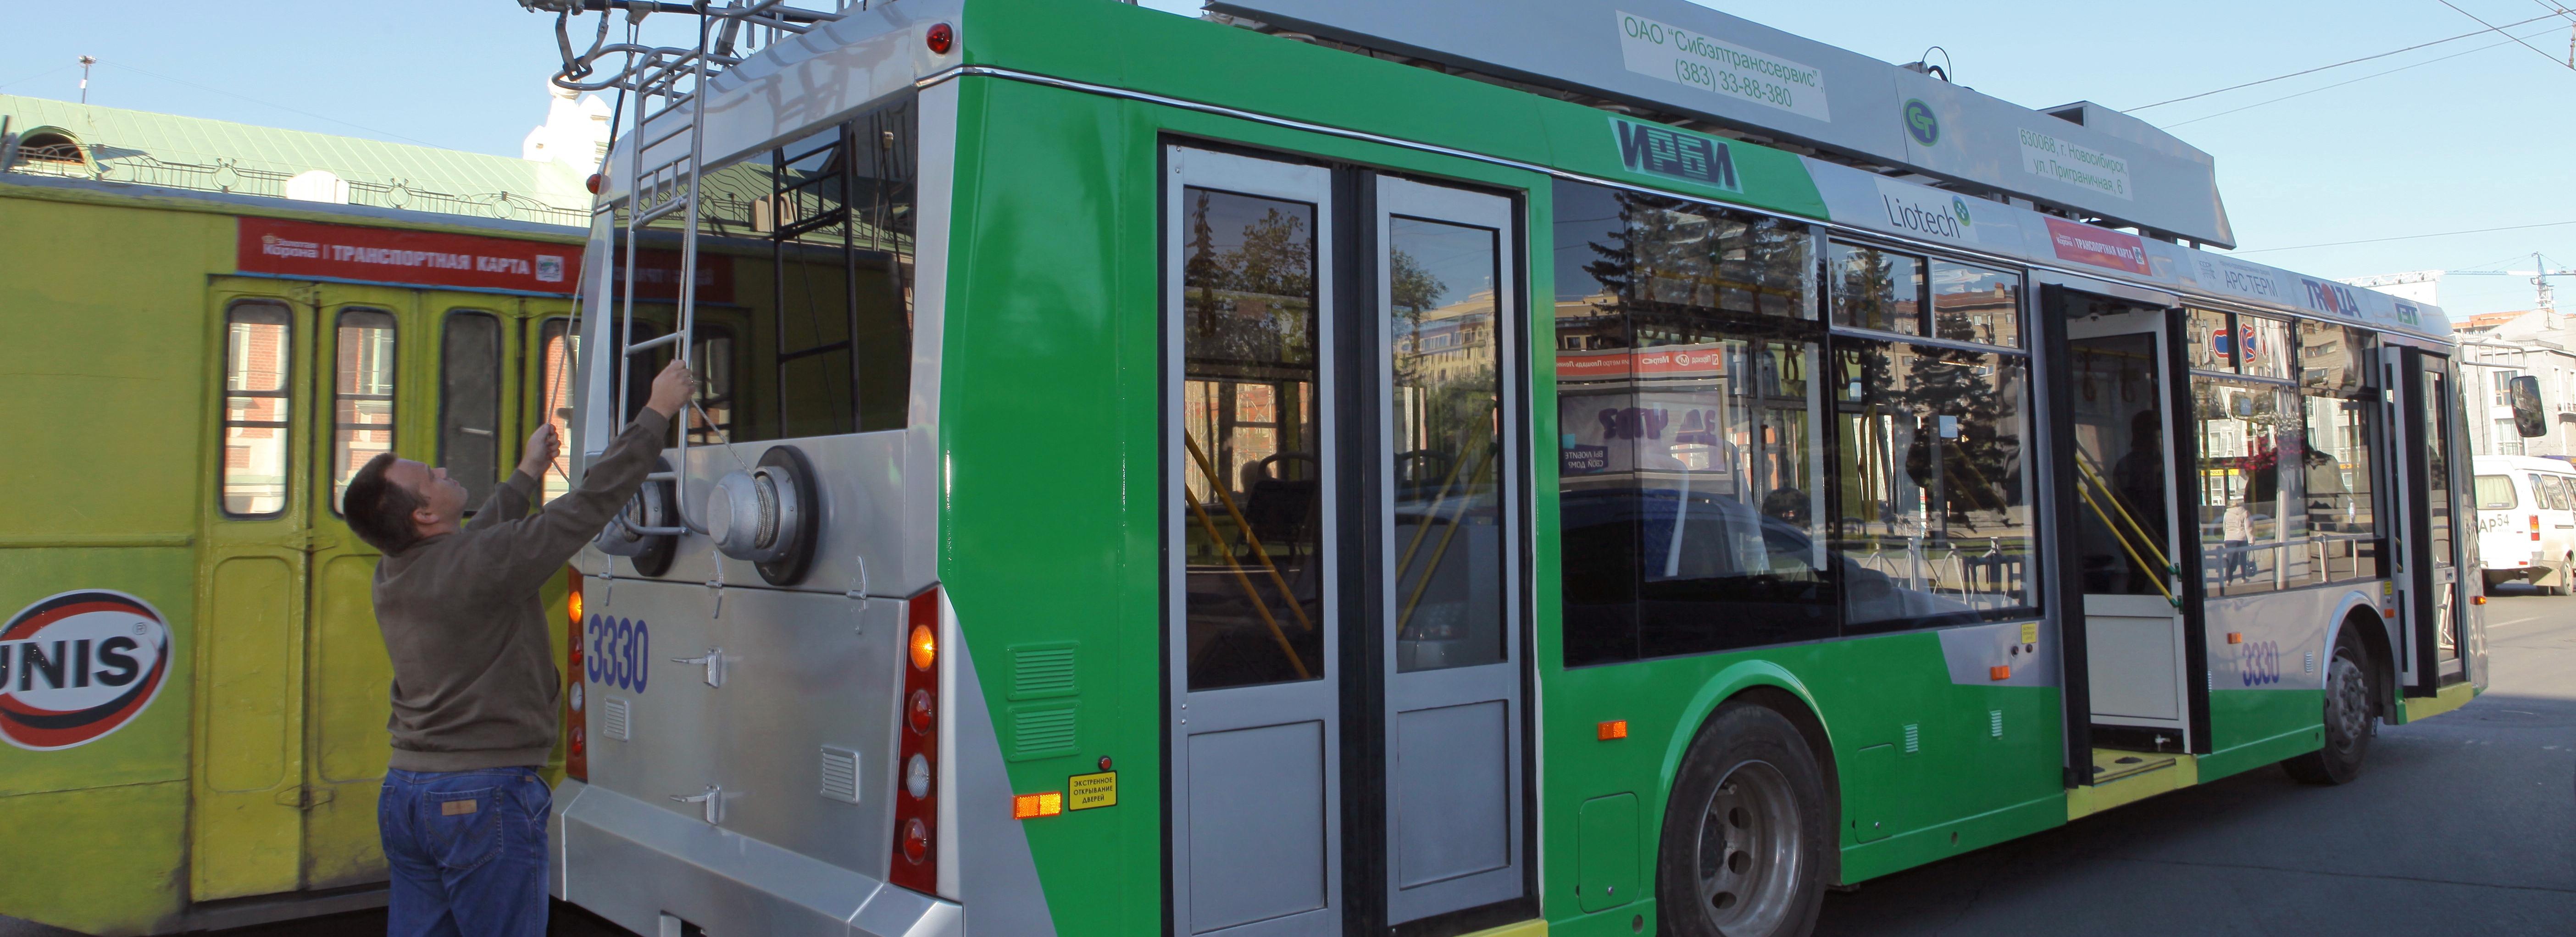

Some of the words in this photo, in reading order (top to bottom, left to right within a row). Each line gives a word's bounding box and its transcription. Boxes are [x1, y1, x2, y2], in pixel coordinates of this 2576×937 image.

[1625, 17, 1664, 44] ОАО
[1676, 58, 1715, 92] (383)
[1719, 70, 1792, 107] 33-88-380
[1617, 120, 1735, 187] ИРБИ
[2021, 129, 2059, 157] 630068,
[2061, 144, 2067, 156] г.
[2068, 143, 2127, 177] Новосибирск,
[2033, 159, 2048, 175] ул.
[2050, 159, 2116, 194] Приграничная,
[2117, 179, 2123, 194] 6
[1883, 194, 1960, 238] Liotech
[262, 244, 320, 258] Корона
[332, 245, 471, 270] ТРАНСПОРТНАЯ
[477, 256, 530, 275] КАРТА
[2075, 238, 2117, 256] ТРАНСПОРТНАЯ
[2116, 246, 2134, 260] КАРТА
[2246, 275, 2278, 297] ТЕРМ
[588, 613, 649, 694] 3330
[2242, 640, 2280, 687] 3330
[1073, 786, 1112, 795] ОТКРЫВАНИЕ
[1074, 777, 1112, 787] ЭКСТРЕННОЕ
[1082, 794, 1105, 804] ДВЕРЕЙ
